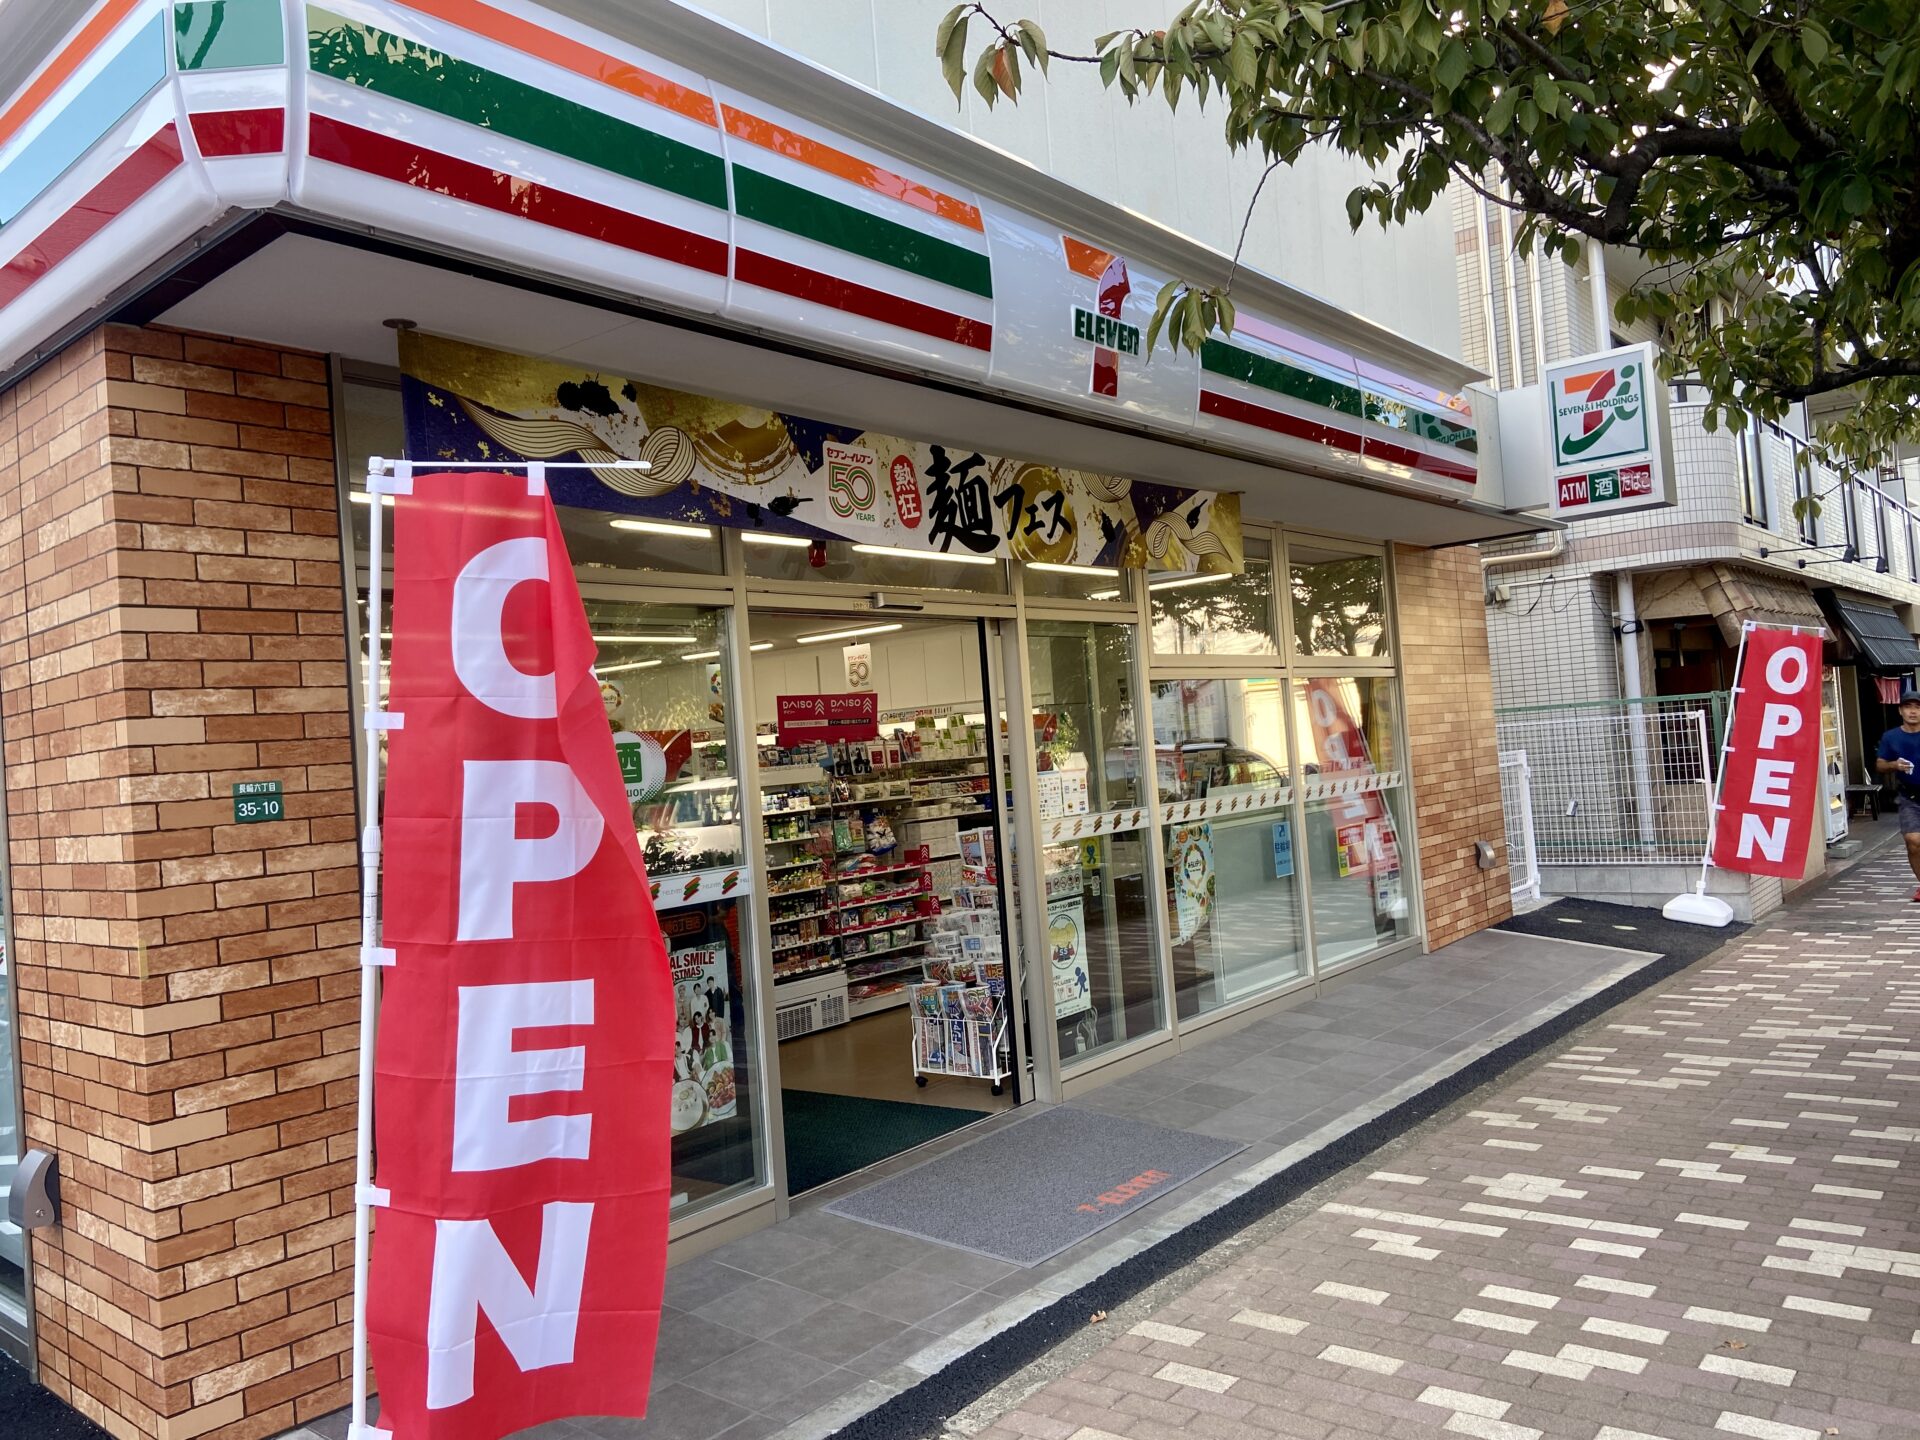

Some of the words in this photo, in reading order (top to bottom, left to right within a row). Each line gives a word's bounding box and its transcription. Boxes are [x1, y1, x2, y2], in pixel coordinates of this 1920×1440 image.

[1595, 393, 1639, 410] HOLDINGS
[828, 460, 876, 518] 50
[893, 463, 920, 520] 熱狂
[1560, 481, 1587, 502] ATM
[1594, 478, 1614, 497] 酒
[1621, 471, 1650, 492] たばこ
[855, 512, 876, 522] YEARS
[849, 661, 869, 687] 50
[782, 700, 813, 709] DAISO
[830, 699, 861, 708] DAISO
[1736, 646, 1808, 863] OPEN
[238, 800, 279, 817] 35-10
[669, 956, 683, 970] AL
[683, 951, 715, 967] SMILE
[427, 537, 605, 1410] OPEN
